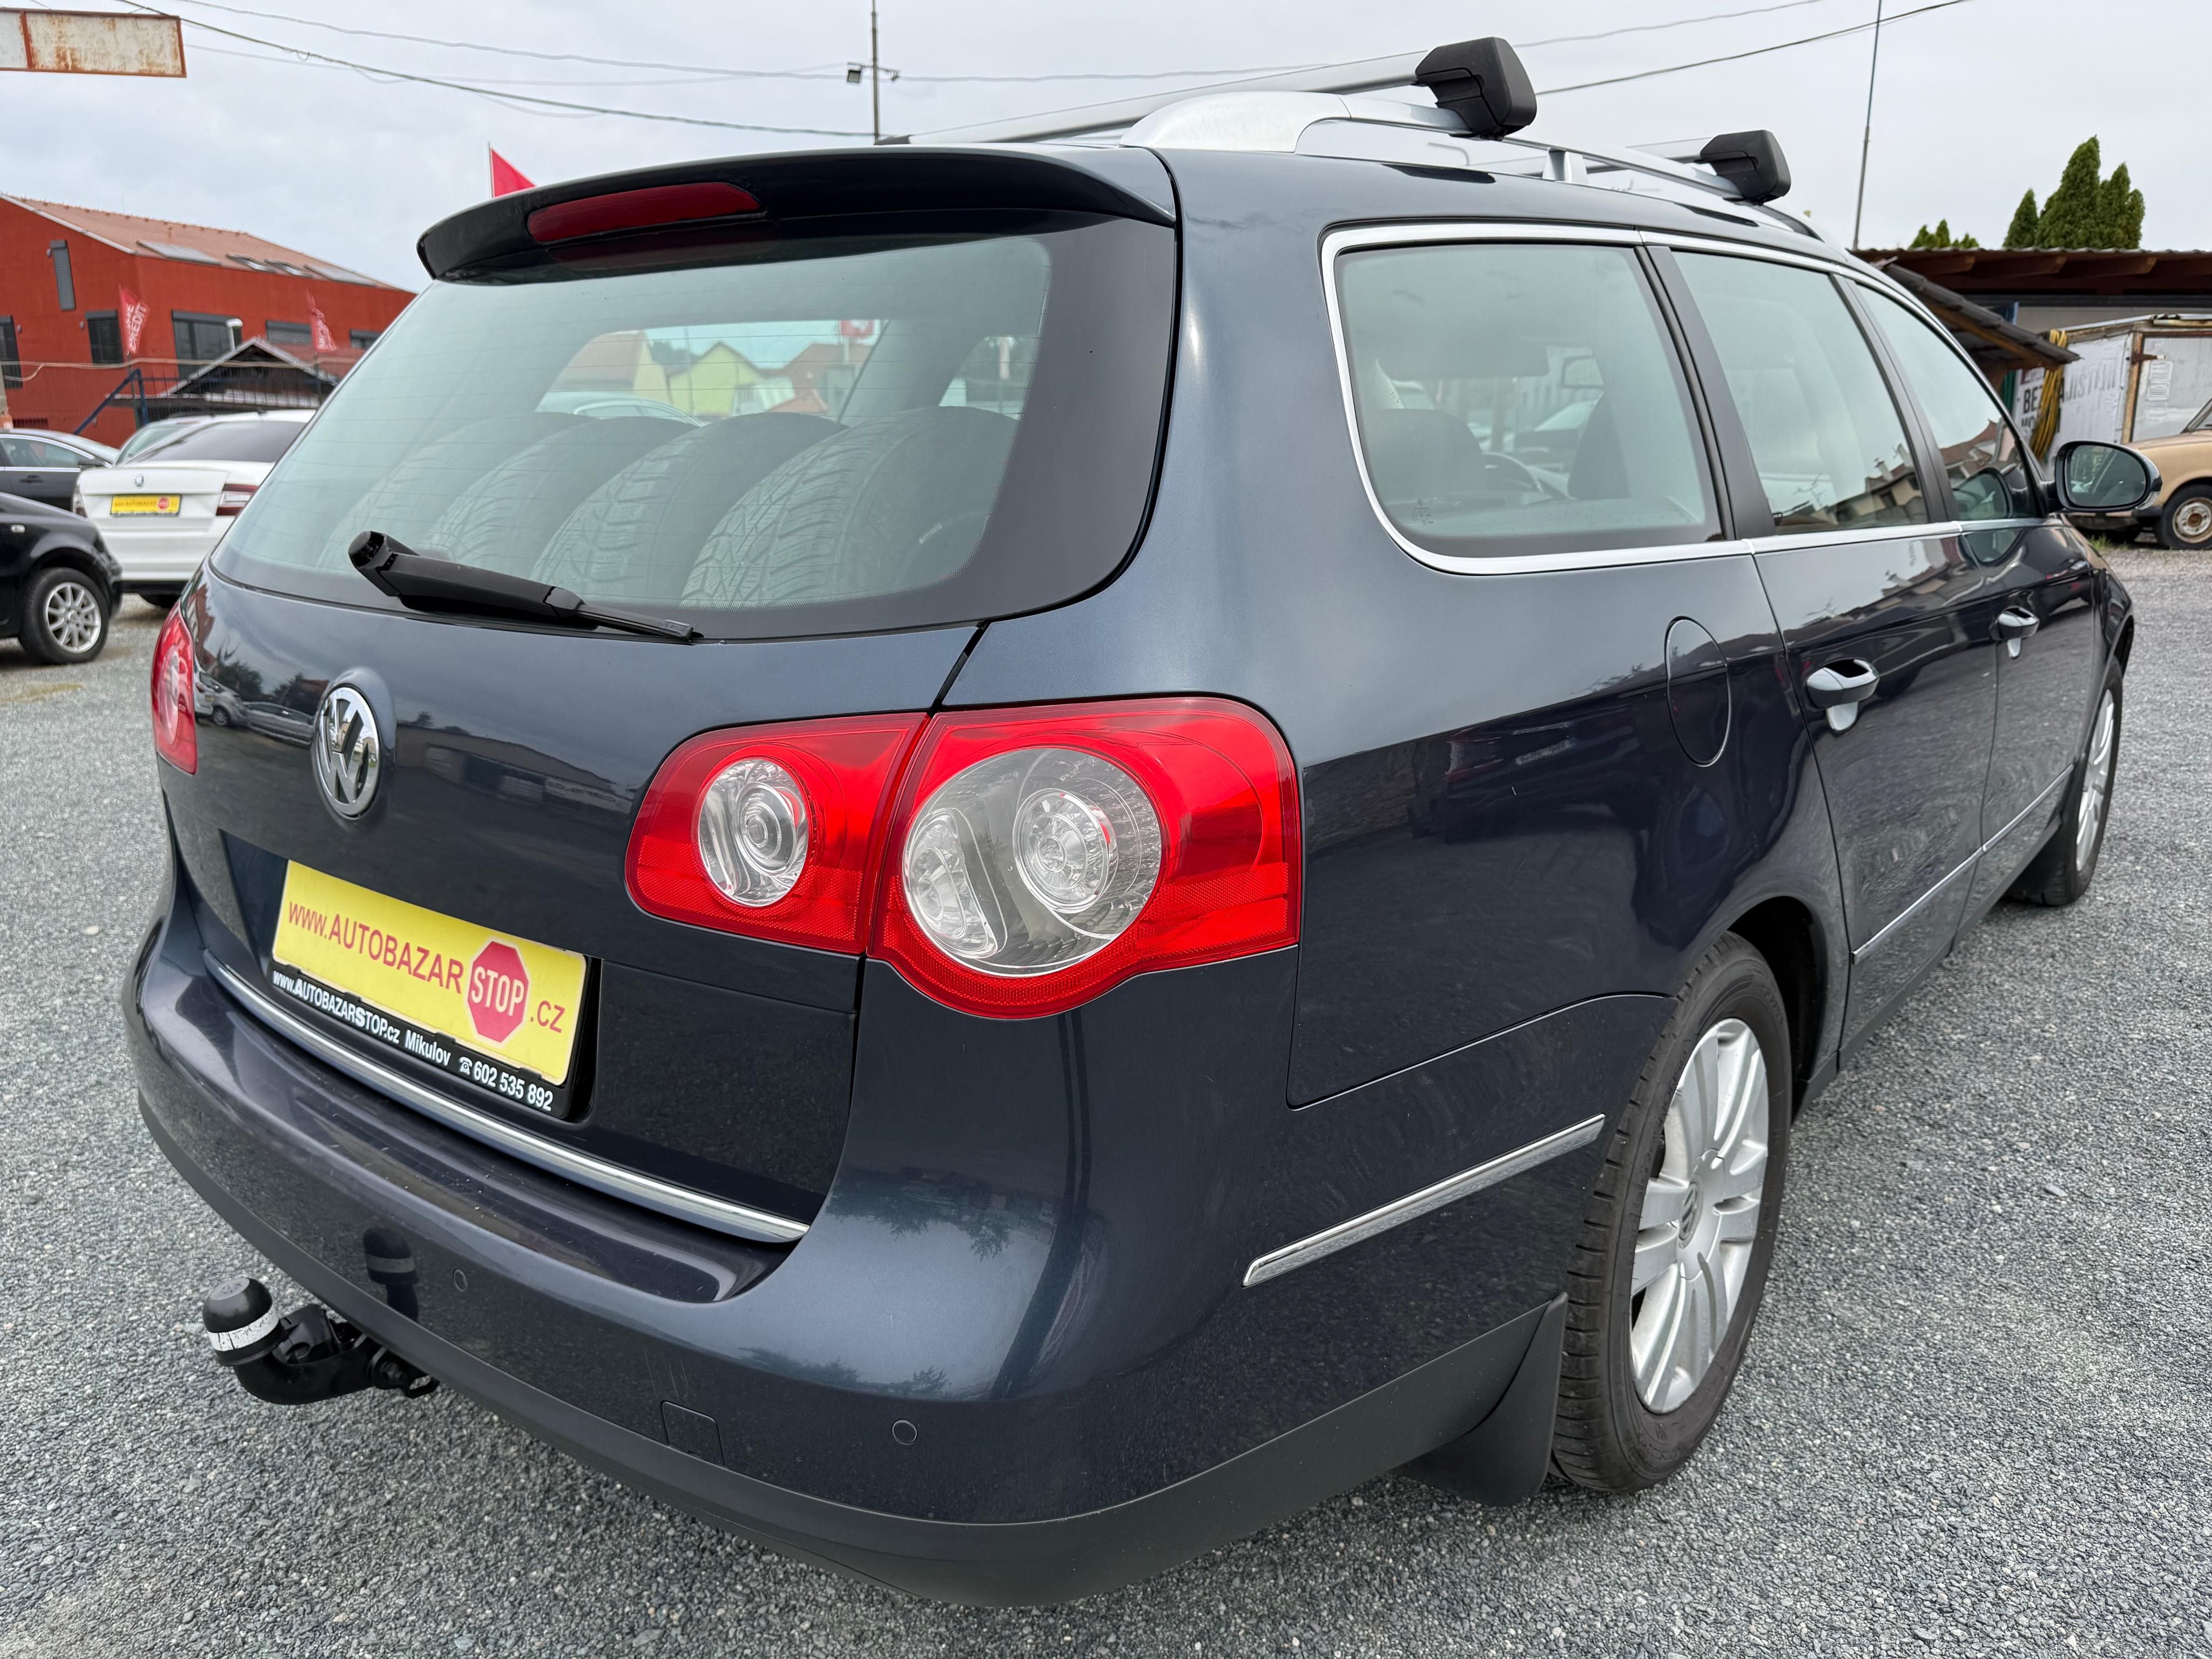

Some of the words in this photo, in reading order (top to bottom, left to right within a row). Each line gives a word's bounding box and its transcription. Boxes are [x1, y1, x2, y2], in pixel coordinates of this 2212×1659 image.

[471, 966, 524, 1017] STOP
[404, 1029, 451, 1067] Mikulov
[473, 1060, 498, 1088] 602
[499, 1071, 525, 1100] 535
[527, 1083, 554, 1112] 892
